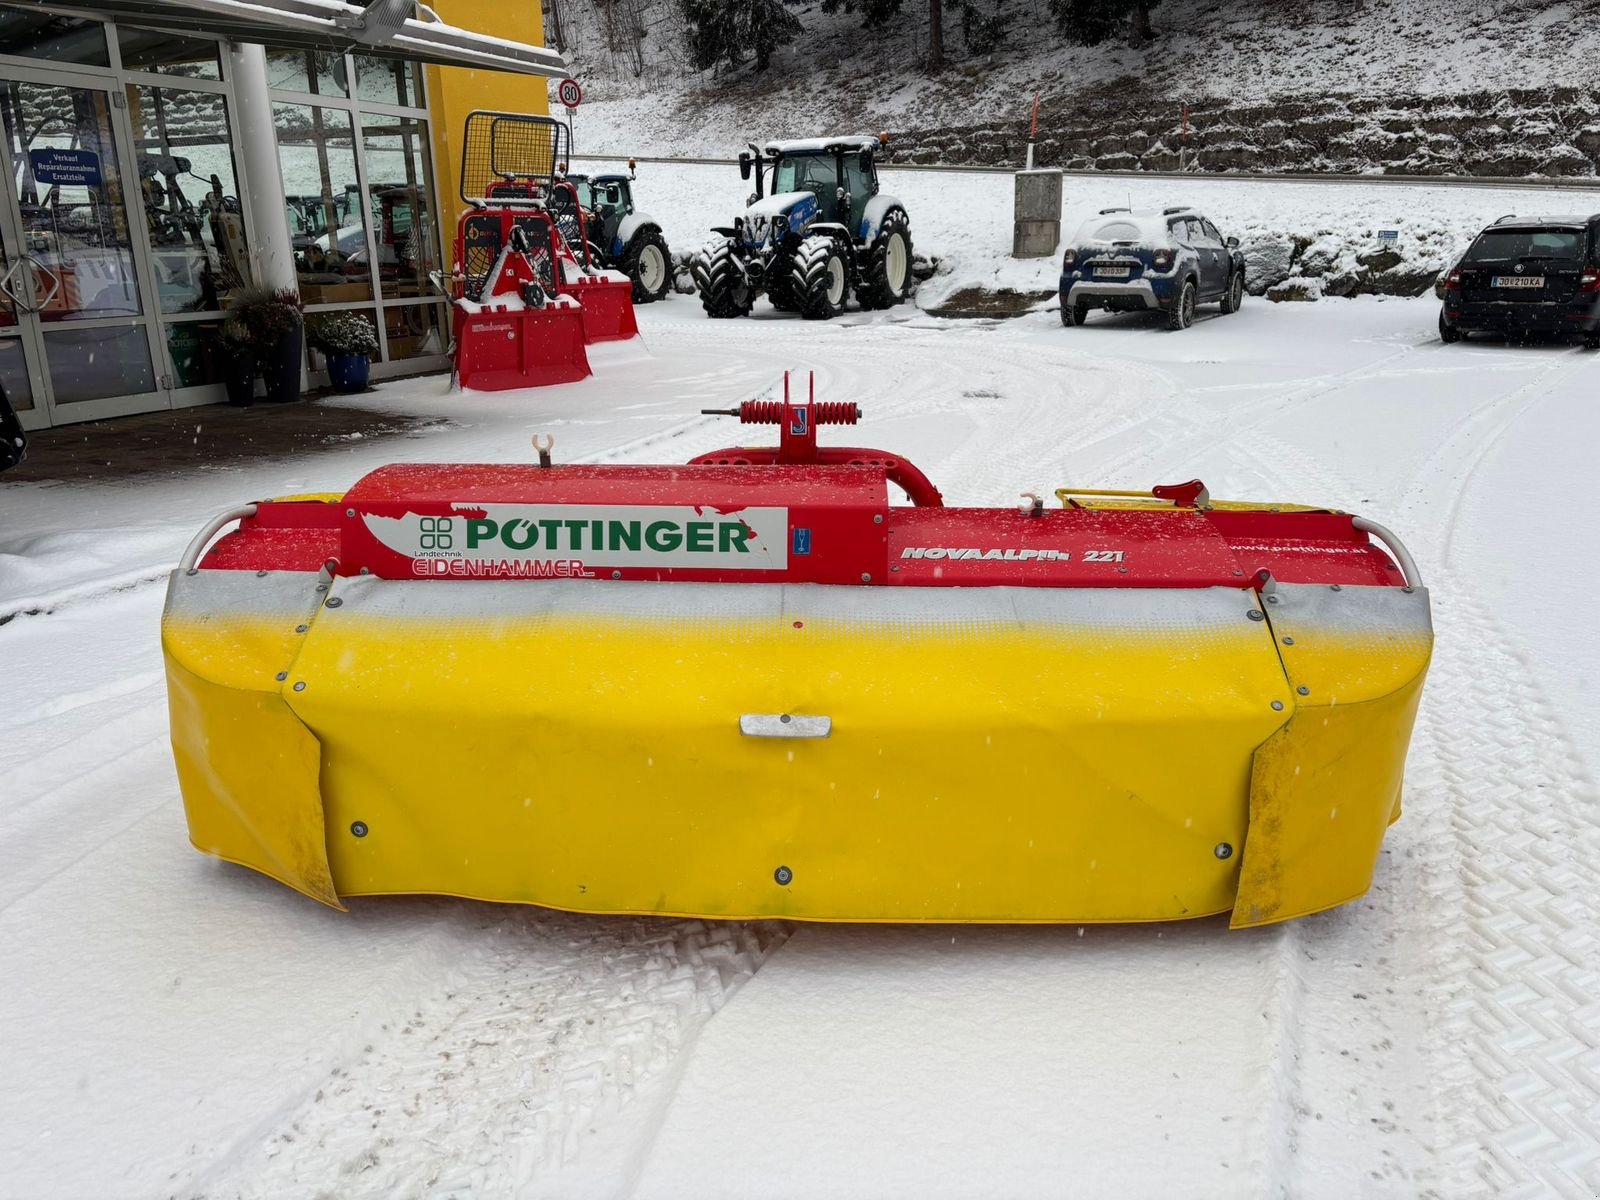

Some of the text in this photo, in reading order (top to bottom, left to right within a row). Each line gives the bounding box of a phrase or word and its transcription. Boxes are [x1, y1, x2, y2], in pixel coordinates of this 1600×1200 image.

[564, 85, 577, 101] 80
[52, 153, 79, 162] Verkauf
[37, 162, 97, 173] Reparaturannahme
[52, 172, 86, 182] Ersatzteile
[466, 518, 750, 553] PÖTTINGER
[414, 550, 463, 558] Landtechnik
[1229, 545, 1368, 554] www.poettinger.at
[1082, 550, 1125, 563] 221
[411, 558, 585, 577] EIDENHAMMER
